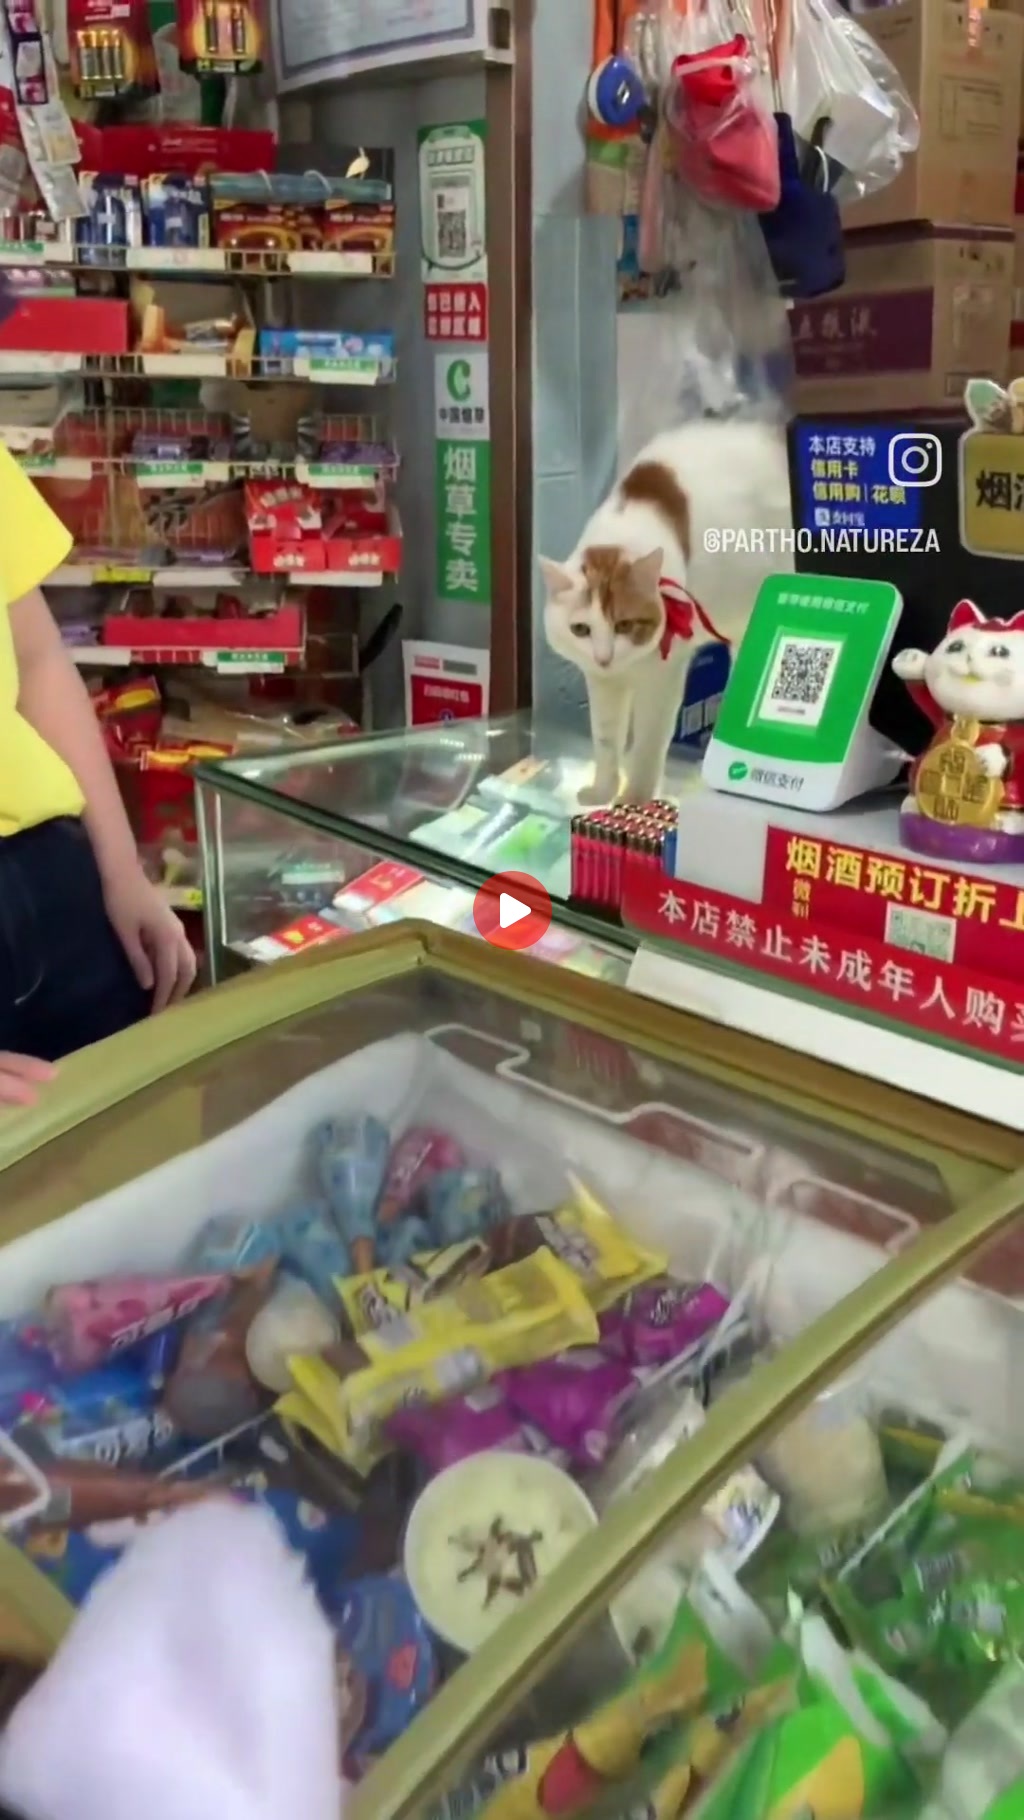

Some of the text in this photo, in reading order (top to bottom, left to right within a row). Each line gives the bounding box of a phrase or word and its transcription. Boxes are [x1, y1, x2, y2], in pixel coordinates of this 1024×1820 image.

[808, 435, 877, 457] 本店支持
[811, 458, 859, 479] 信用卡
[813, 481, 906, 505] 信用购 花呗
[975, 468, 1024, 512] 烟
[443, 445, 479, 593] 烟草专卖
[832, 511, 866, 527] 支付宝
[751, 767, 805, 793] 微信支付
